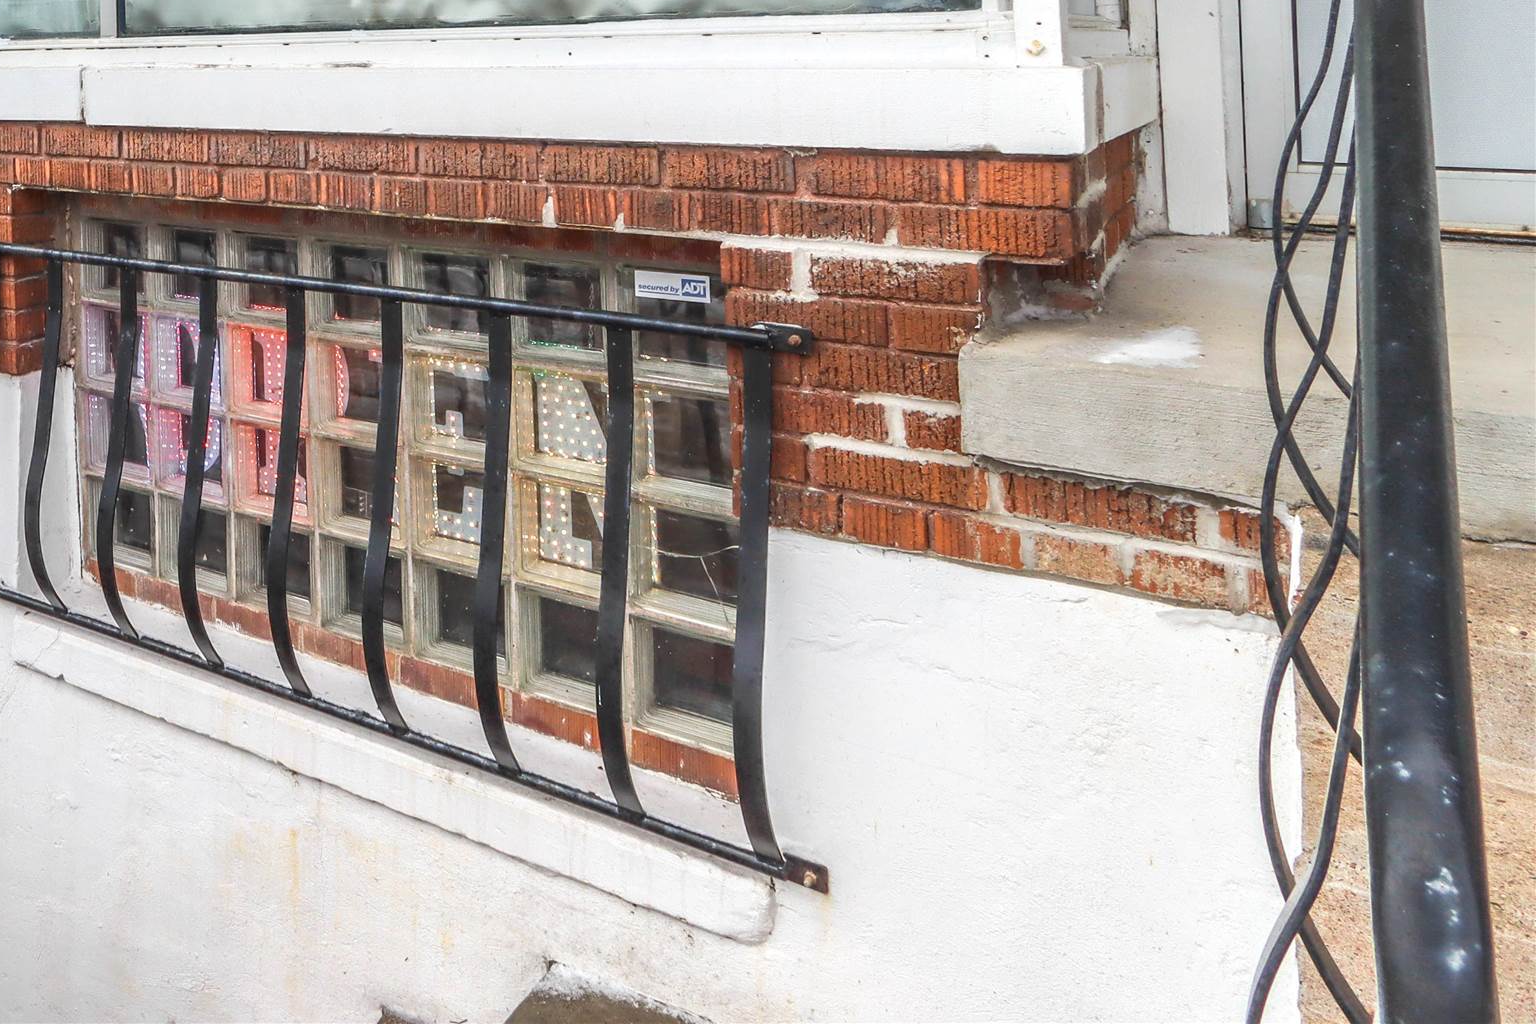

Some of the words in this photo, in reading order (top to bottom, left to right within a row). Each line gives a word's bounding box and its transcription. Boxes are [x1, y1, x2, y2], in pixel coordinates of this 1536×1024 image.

[638, 283, 669, 292] secured
[670, 285, 680, 294] by
[682, 280, 706, 296] ADT
